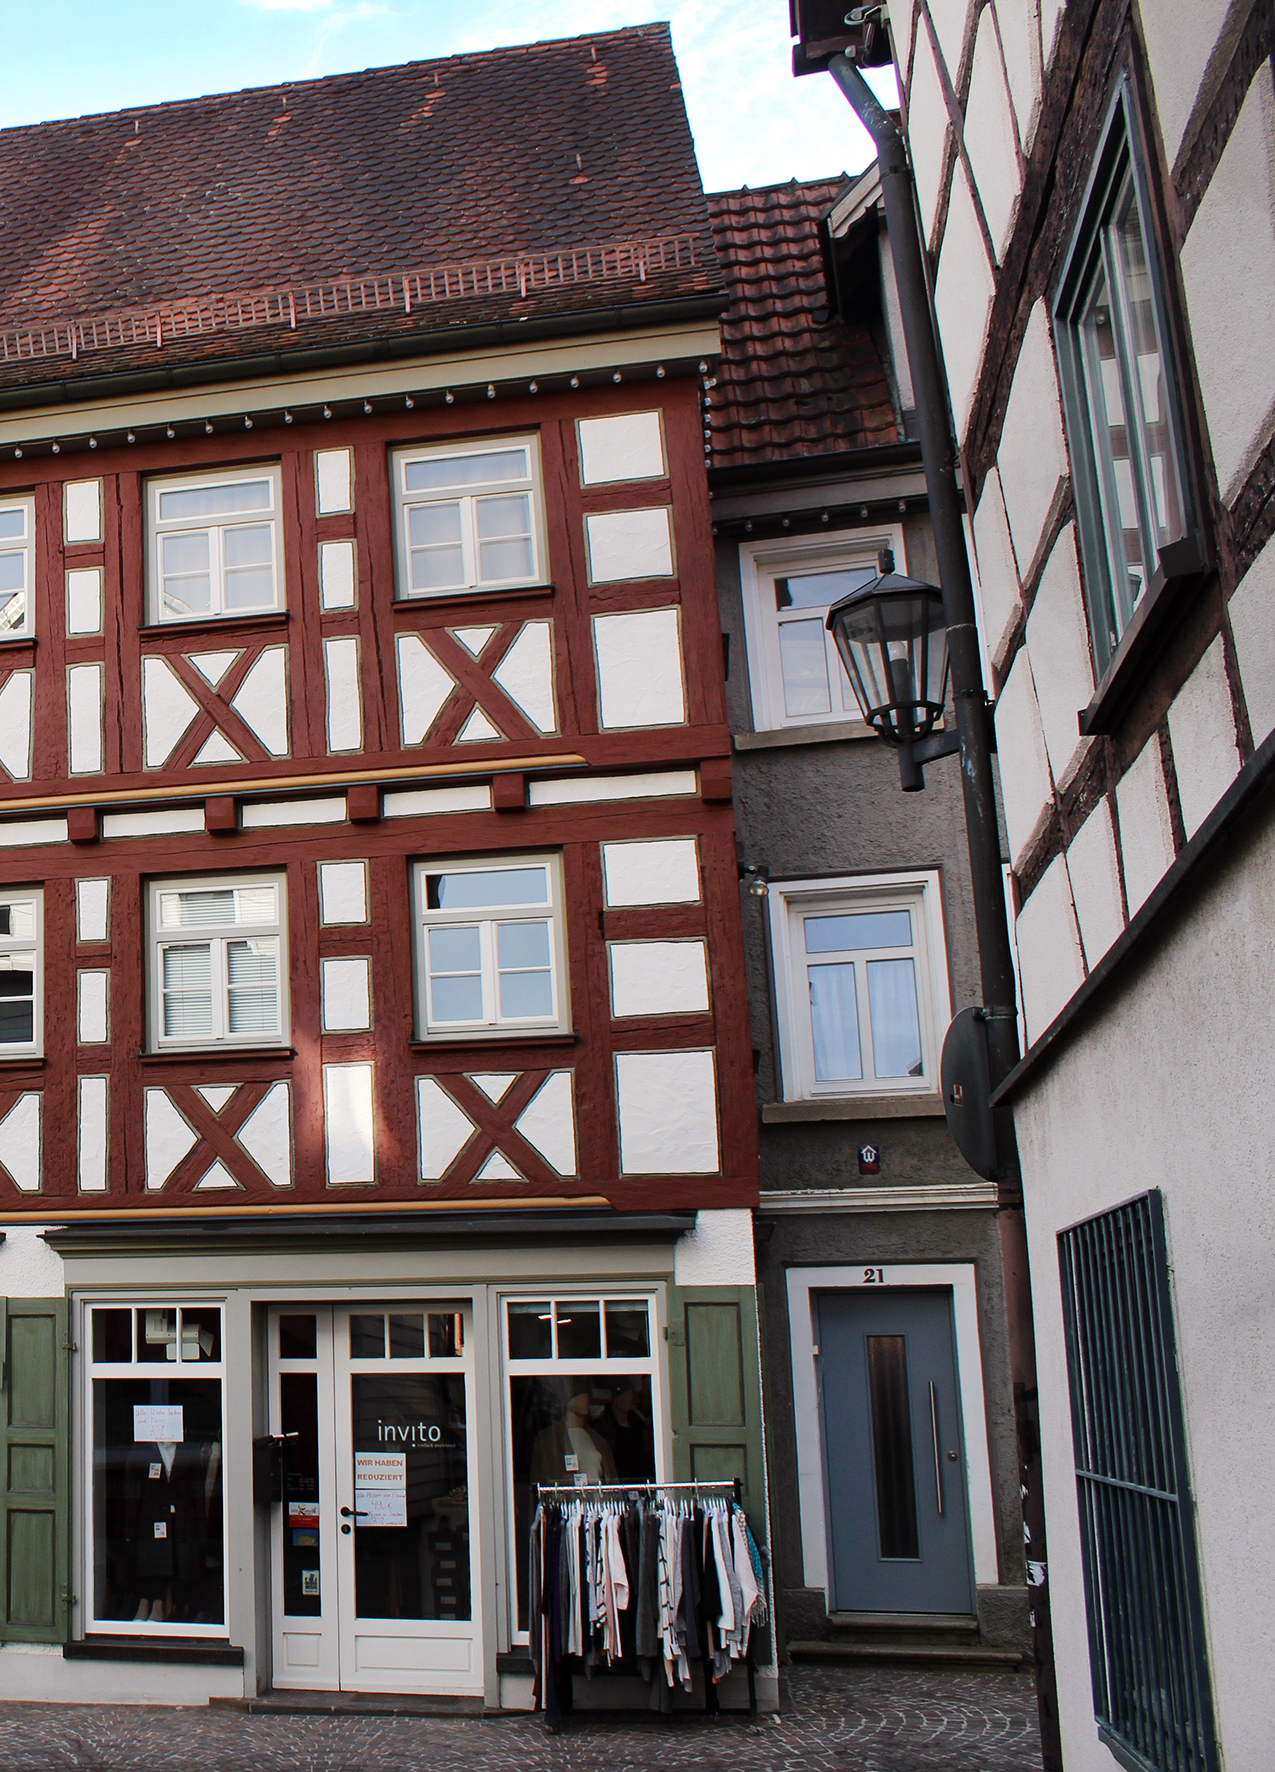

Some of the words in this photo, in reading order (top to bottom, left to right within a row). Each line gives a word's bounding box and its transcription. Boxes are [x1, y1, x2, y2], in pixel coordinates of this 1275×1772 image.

[863, 1268, 884, 1283] 21
[377, 1419, 441, 1442] invito
[357, 1459, 373, 1467] WIR
[374, 1459, 403, 1467] HABEN
[357, 1473, 403, 1481] REDUZIERT
